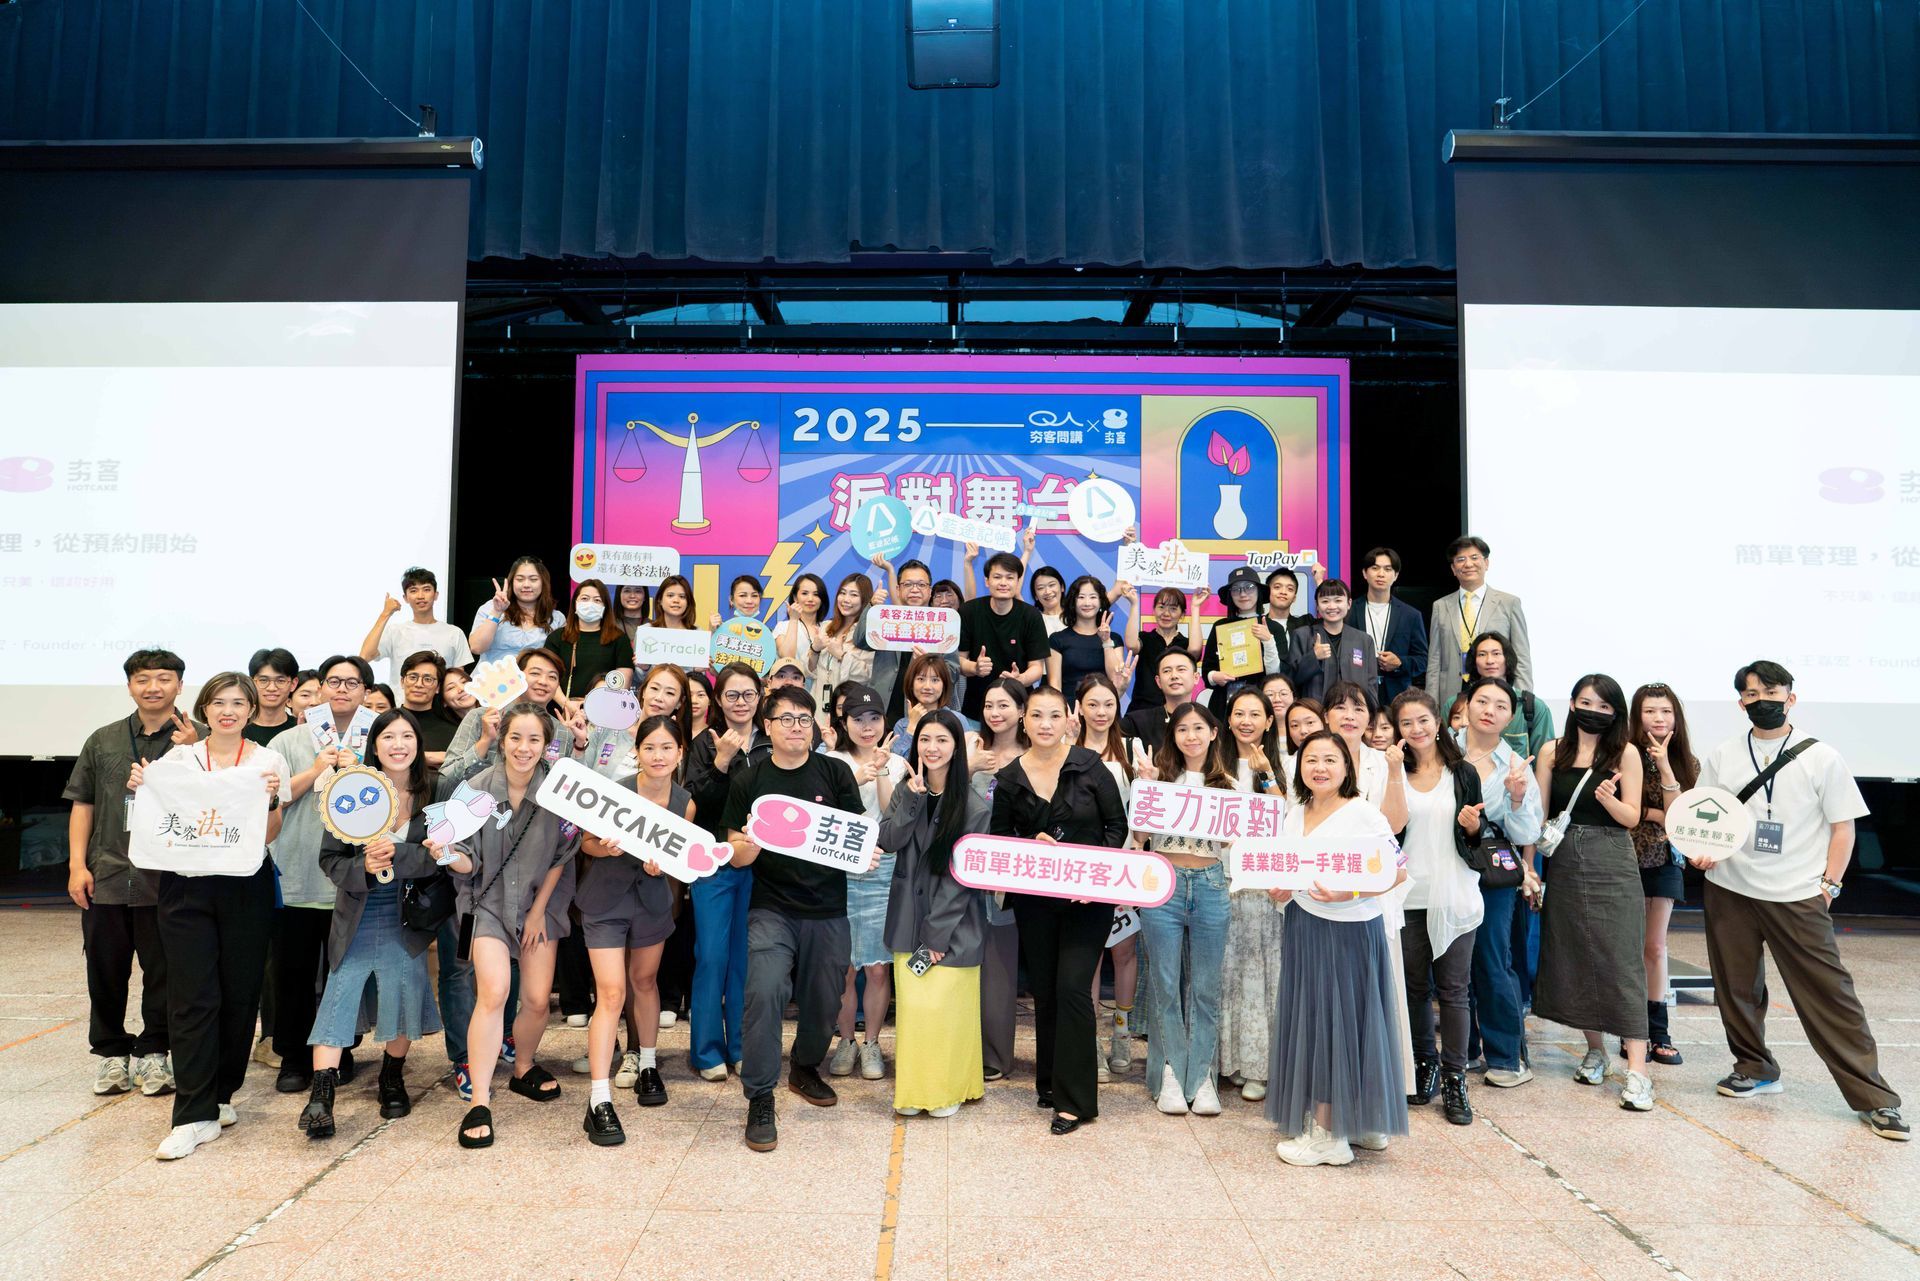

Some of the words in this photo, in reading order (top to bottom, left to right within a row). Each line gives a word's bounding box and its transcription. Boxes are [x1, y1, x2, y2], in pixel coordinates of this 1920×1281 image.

[793, 408, 922, 442] 2025
[1030, 430, 1083, 444] 夯客問講
[67, 459, 121, 482] 夯客
[1125, 543, 1202, 581] 美容法協
[1248, 552, 1299, 569] TapPay
[880, 609, 947, 622] 美容法協會員
[662, 642, 706, 655] Tracle
[156, 808, 241, 843] 美容法協
[552, 774, 687, 858] HOTCAKE
[815, 814, 869, 853] 夯客
[812, 844, 860, 864] HOTCAKE
[1241, 852, 1363, 875] 美業趨勢一手掌握
[963, 848, 1137, 889] 簡單找到好客人
